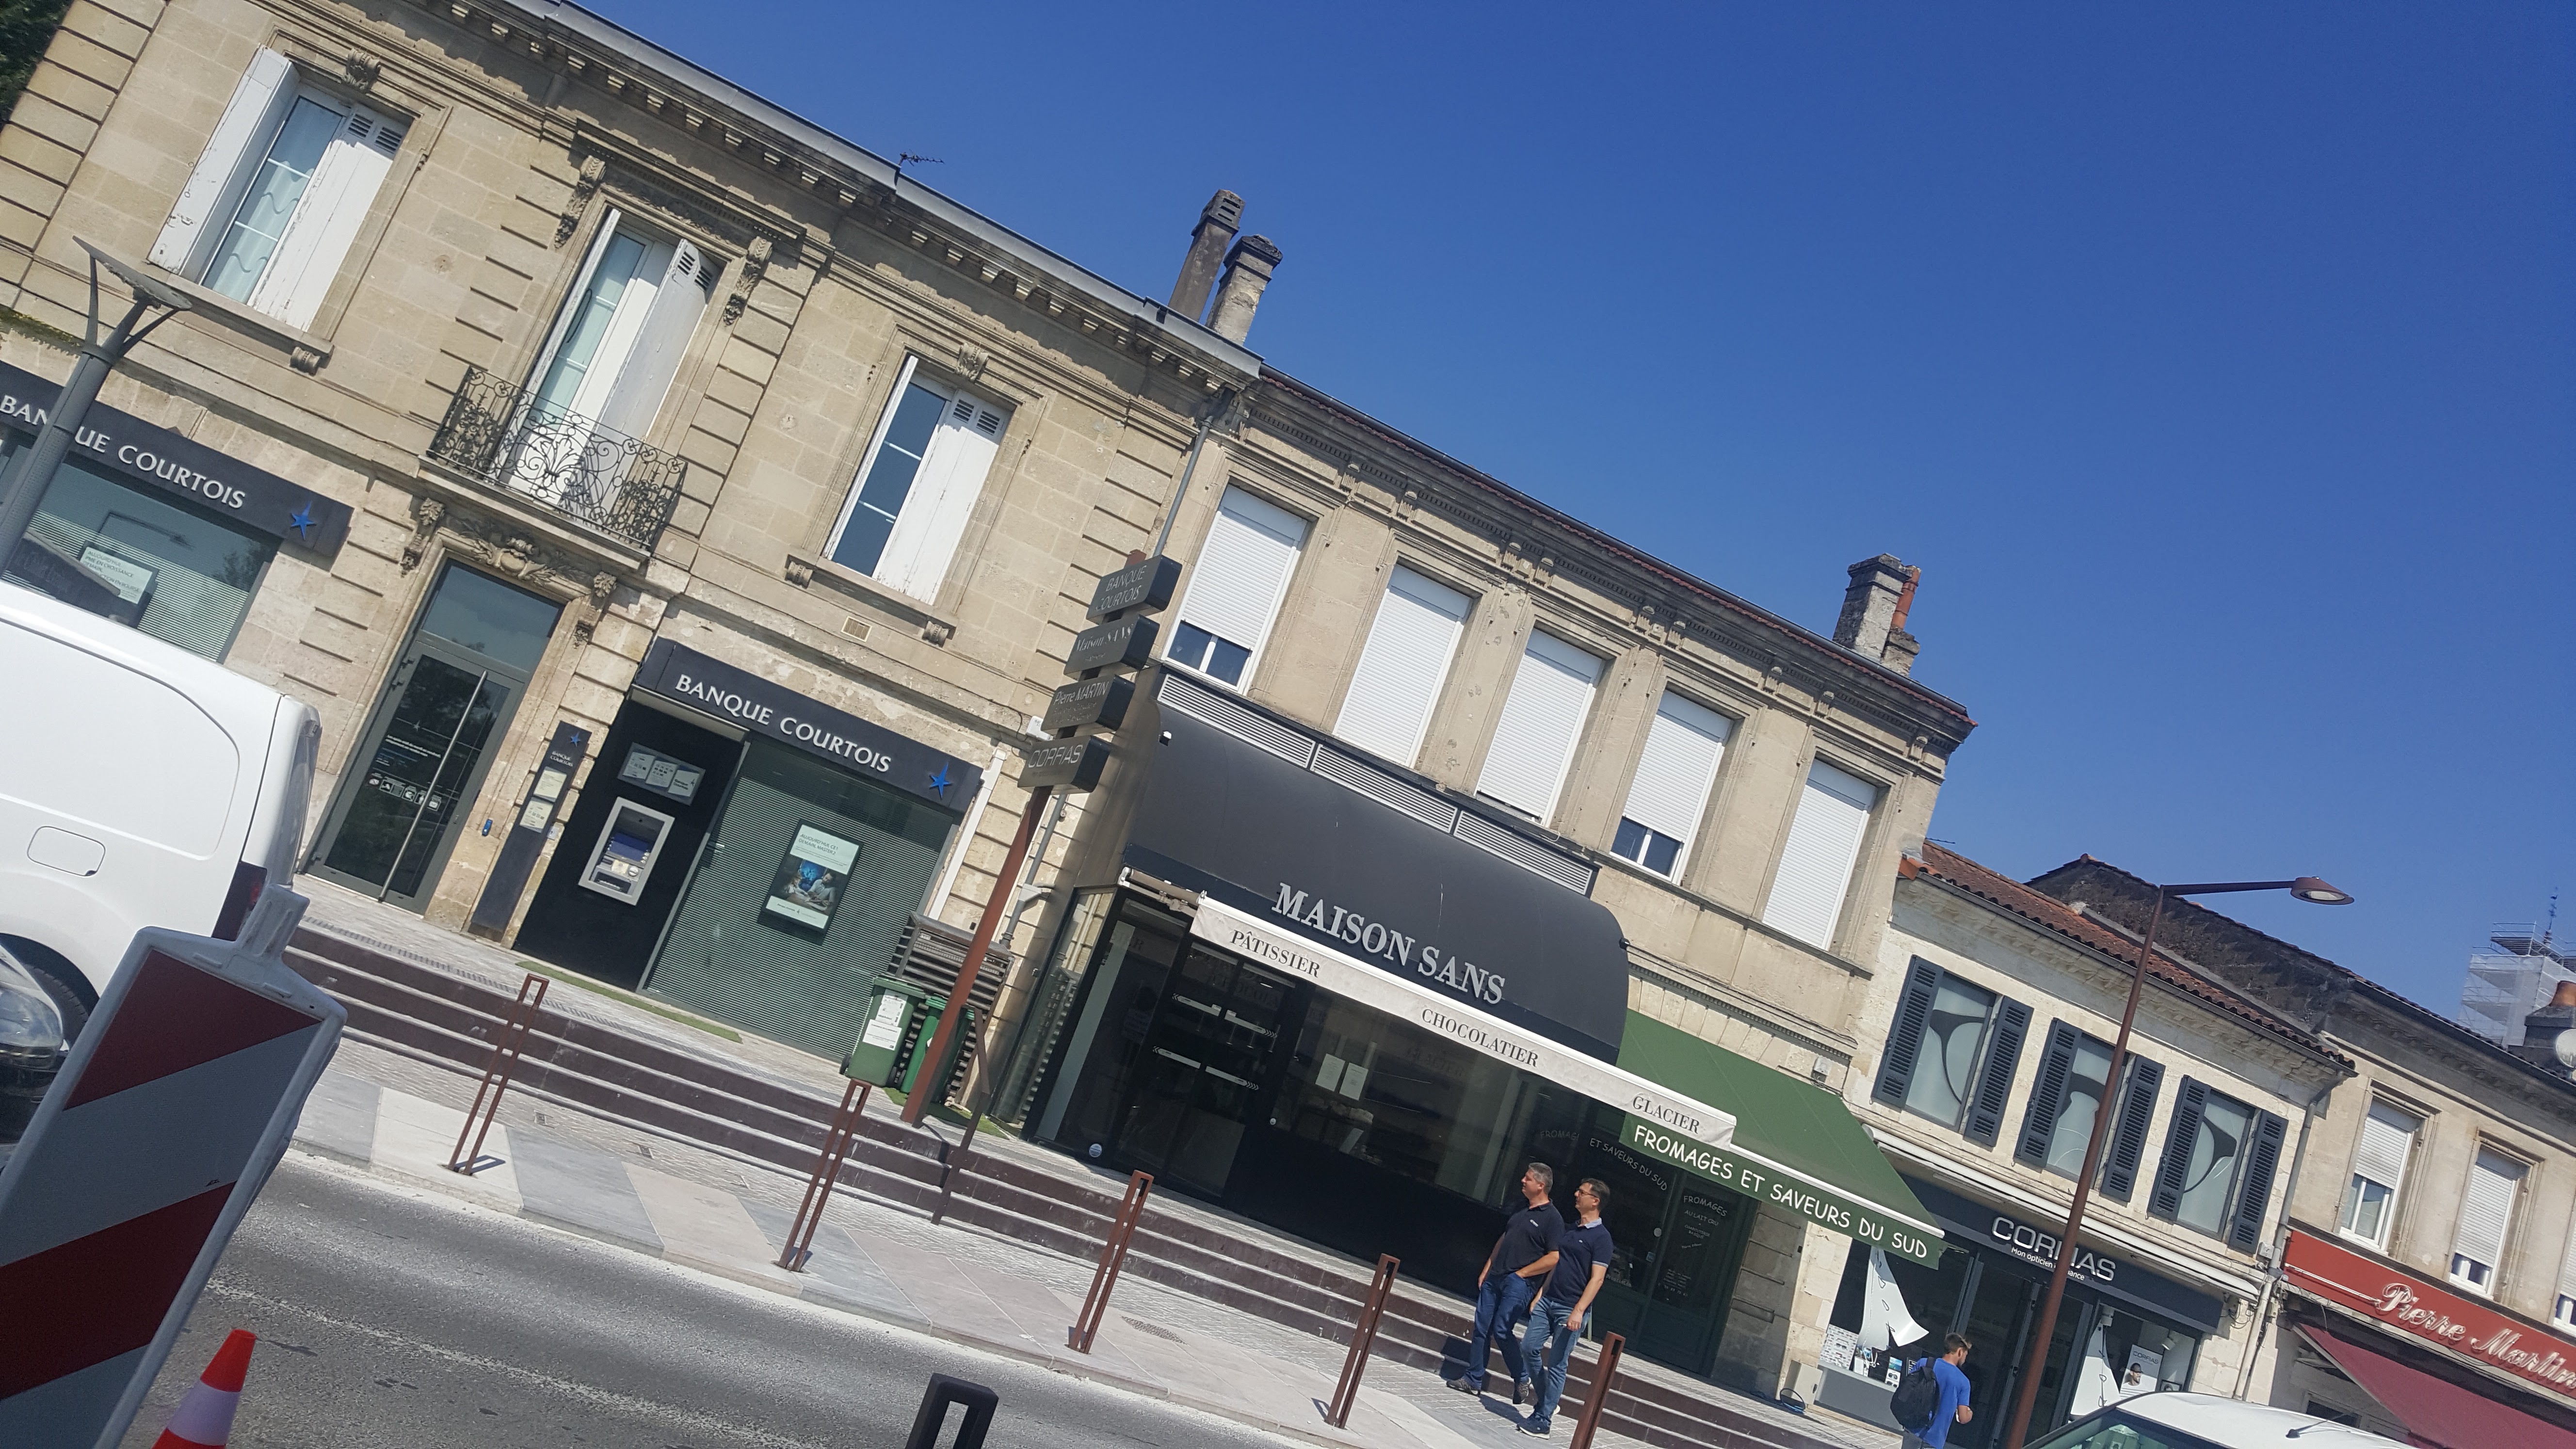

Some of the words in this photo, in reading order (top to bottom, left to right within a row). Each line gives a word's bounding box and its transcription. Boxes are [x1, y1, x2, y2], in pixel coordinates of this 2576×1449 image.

[0, 394, 111, 453] BANUE
[118, 445, 246, 509] COURTOIS
[1106, 565, 1147, 592] BANQUE
[1096, 585, 1142, 611] COURTOIS
[1053, 691, 1076, 705] Pierre
[1075, 681, 1109, 701] MARTIN
[675, 674, 773, 725] BANQUE
[780, 717, 891, 772] COURTOIS
[1028, 744, 1083, 768] CORFIAS
[1272, 882, 1415, 966] MAISON
[1418, 946, 1505, 1004] SANS
[1229, 929, 1320, 978] PÂTISSIER
[1422, 1009, 1539, 1067] CHOCOLATIER
[1633, 1096, 1700, 1134] GLACIER
[1541, 1129, 1579, 1142] FROMAG
[1590, 1138, 1602, 1148] ET
[1602, 1143, 1638, 1170] SAVEURS
[1639, 1165, 1652, 1176] DU
[1651, 1174, 1668, 1191] SUD
[1634, 1125, 1733, 1179] FROMAGES
[1741, 1169, 1765, 1192] ET
[1770, 1184, 1851, 1228] SAVEURS
[1859, 1218, 1884, 1241] DU
[1892, 1232, 1927, 1258] SUD
[1684, 1195, 1727, 1216] FROMAGES
[1693, 1212, 1707, 1221] LAIT
[2011, 1247, 2026, 1258] Mon
[2027, 1253, 2053, 1269] opticien
[2376, 1283, 2466, 1341] Pierre
[2133, 1351, 2158, 1364] CORFIAS
